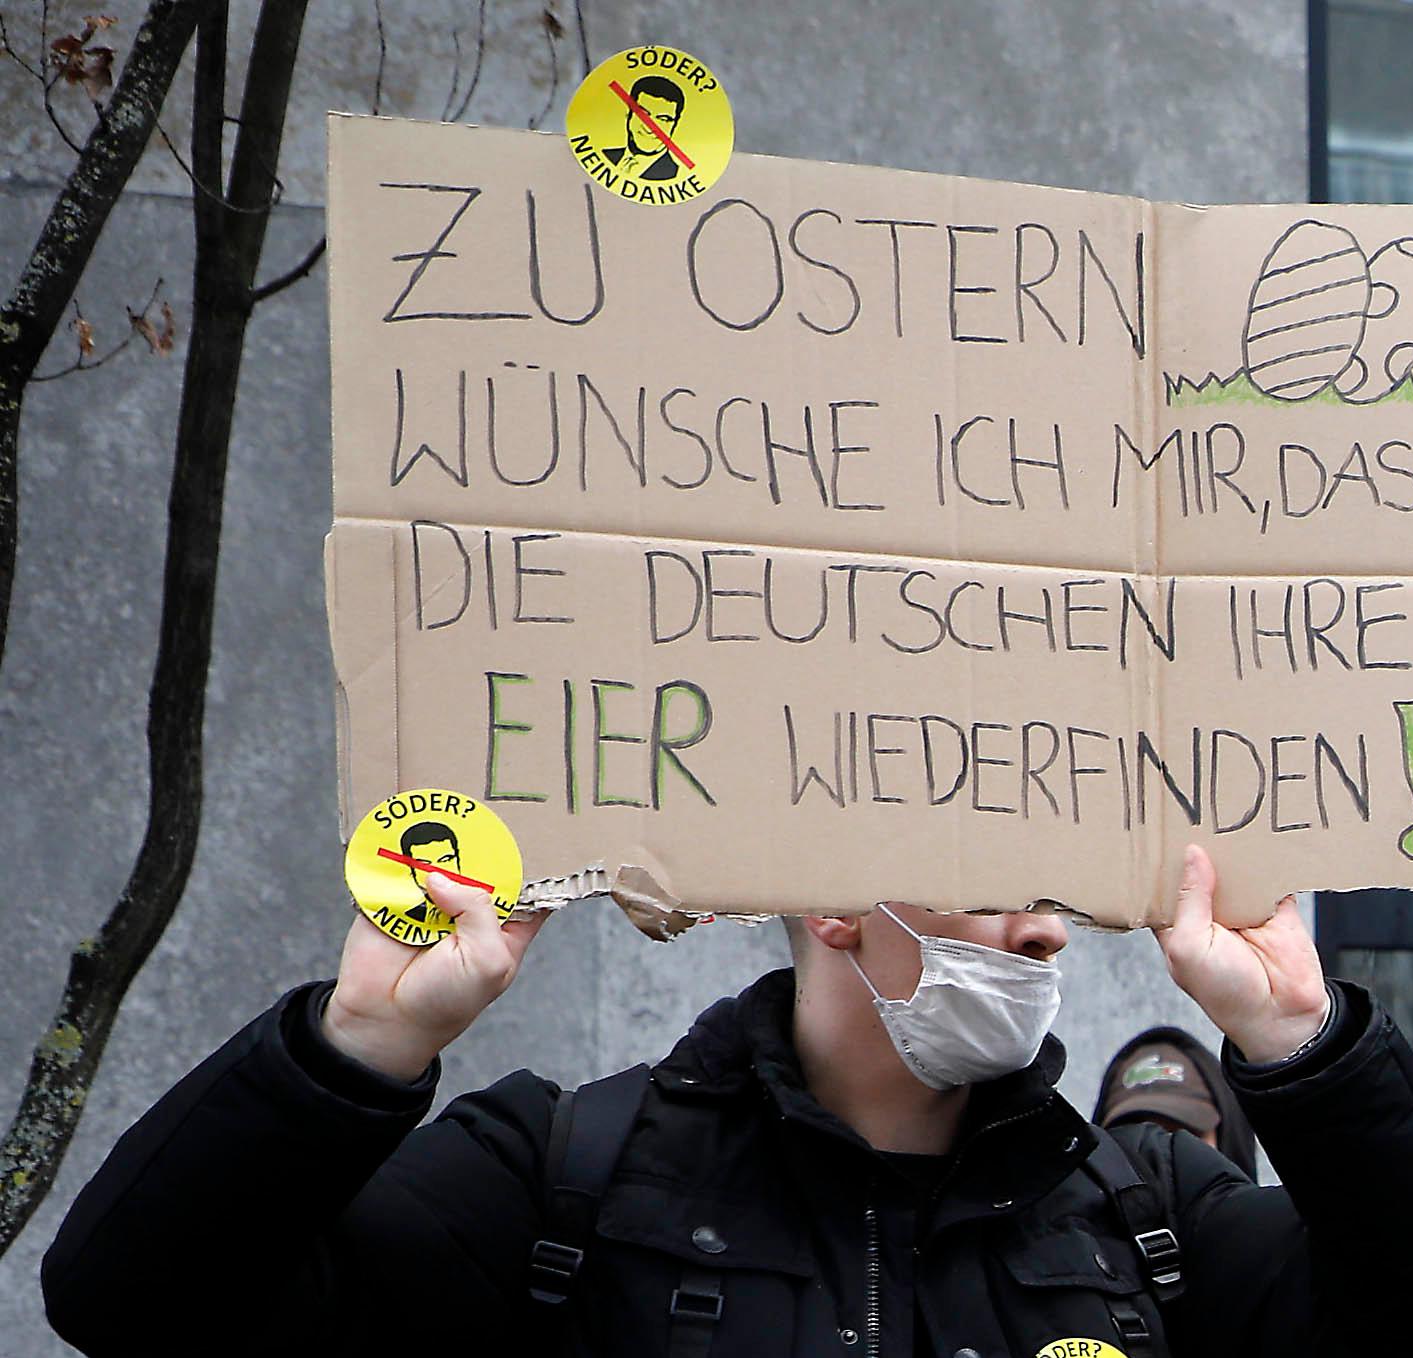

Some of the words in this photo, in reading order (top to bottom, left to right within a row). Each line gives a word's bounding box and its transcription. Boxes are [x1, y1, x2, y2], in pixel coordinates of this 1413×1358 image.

[626, 45, 717, 92] SÖDER?
[570, 135, 619, 188] NEIN
[620, 174, 706, 204] DANKE
[379, 182, 605, 326] ZU
[687, 198, 1146, 361] OSTERN
[389, 361, 886, 511] WÜNSCHE
[934, 414, 1069, 510] ICH
[1112, 422, 1271, 534] MIR,
[411, 520, 575, 631] DIE
[645, 549, 1176, 671] DEUTSCHEN
[1230, 578, 1413, 680] IHRE
[484, 672, 717, 814] EIER
[374, 793, 476, 829] SÖDER?
[373, 905, 431, 944] NEIN
